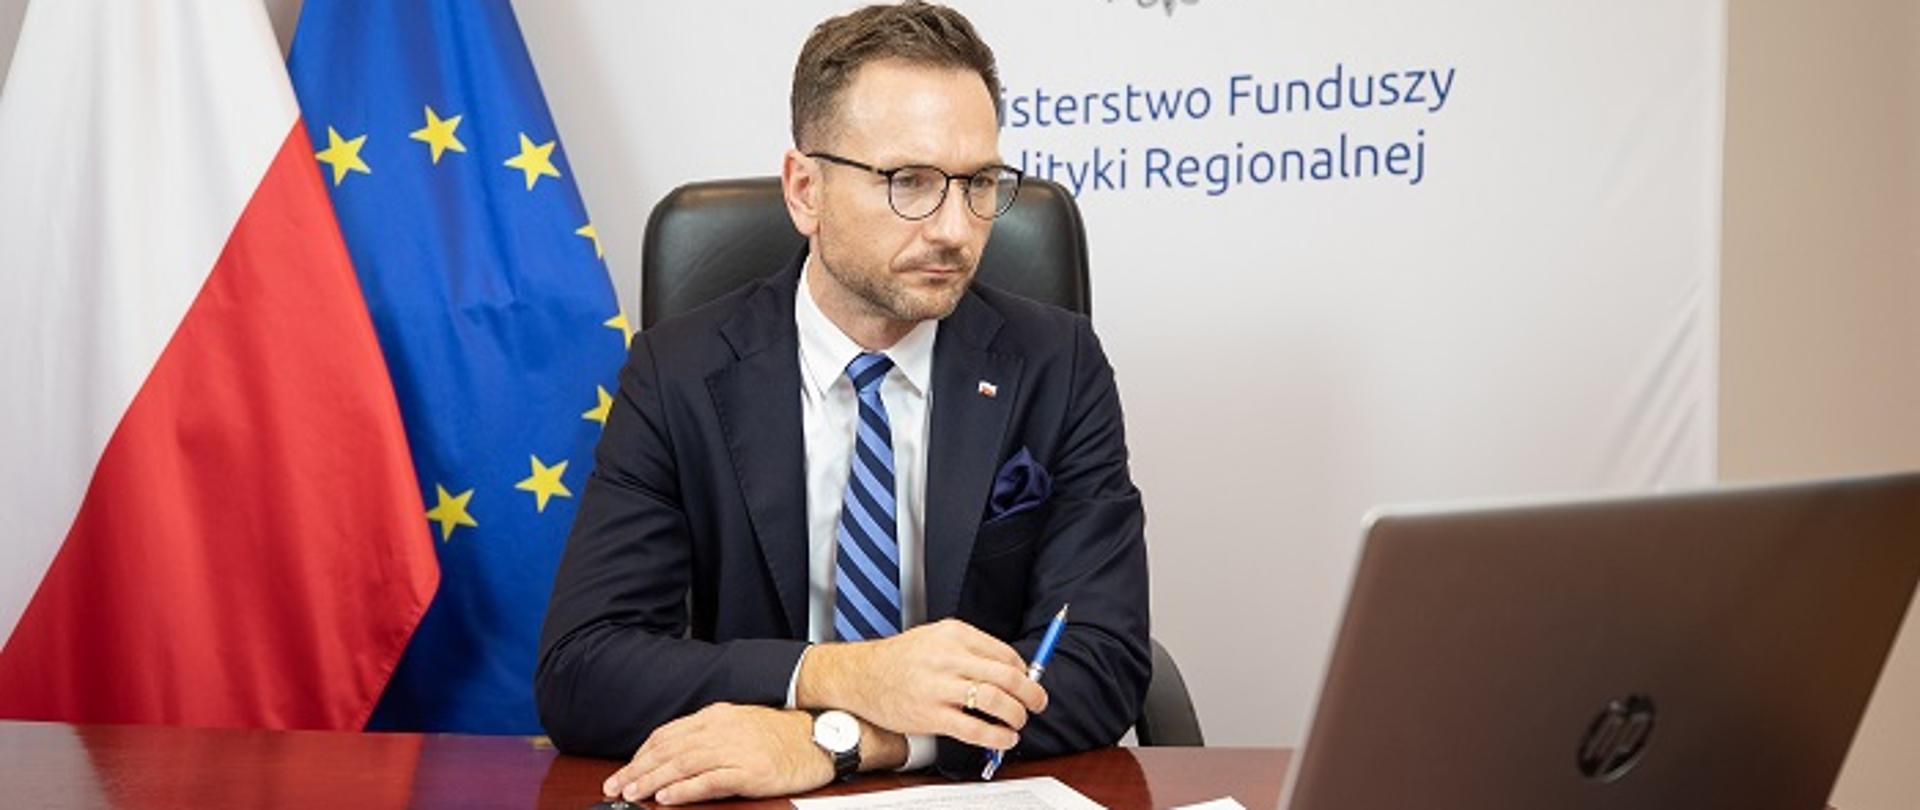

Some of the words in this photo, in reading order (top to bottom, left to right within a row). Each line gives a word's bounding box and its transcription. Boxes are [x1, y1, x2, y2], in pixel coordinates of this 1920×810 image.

[999, 84, 1212, 127] isterstwo
[1229, 62, 1456, 116] Funduszy
[1019, 147, 1127, 199] lityki
[1145, 129, 1426, 196] Regionalnej
